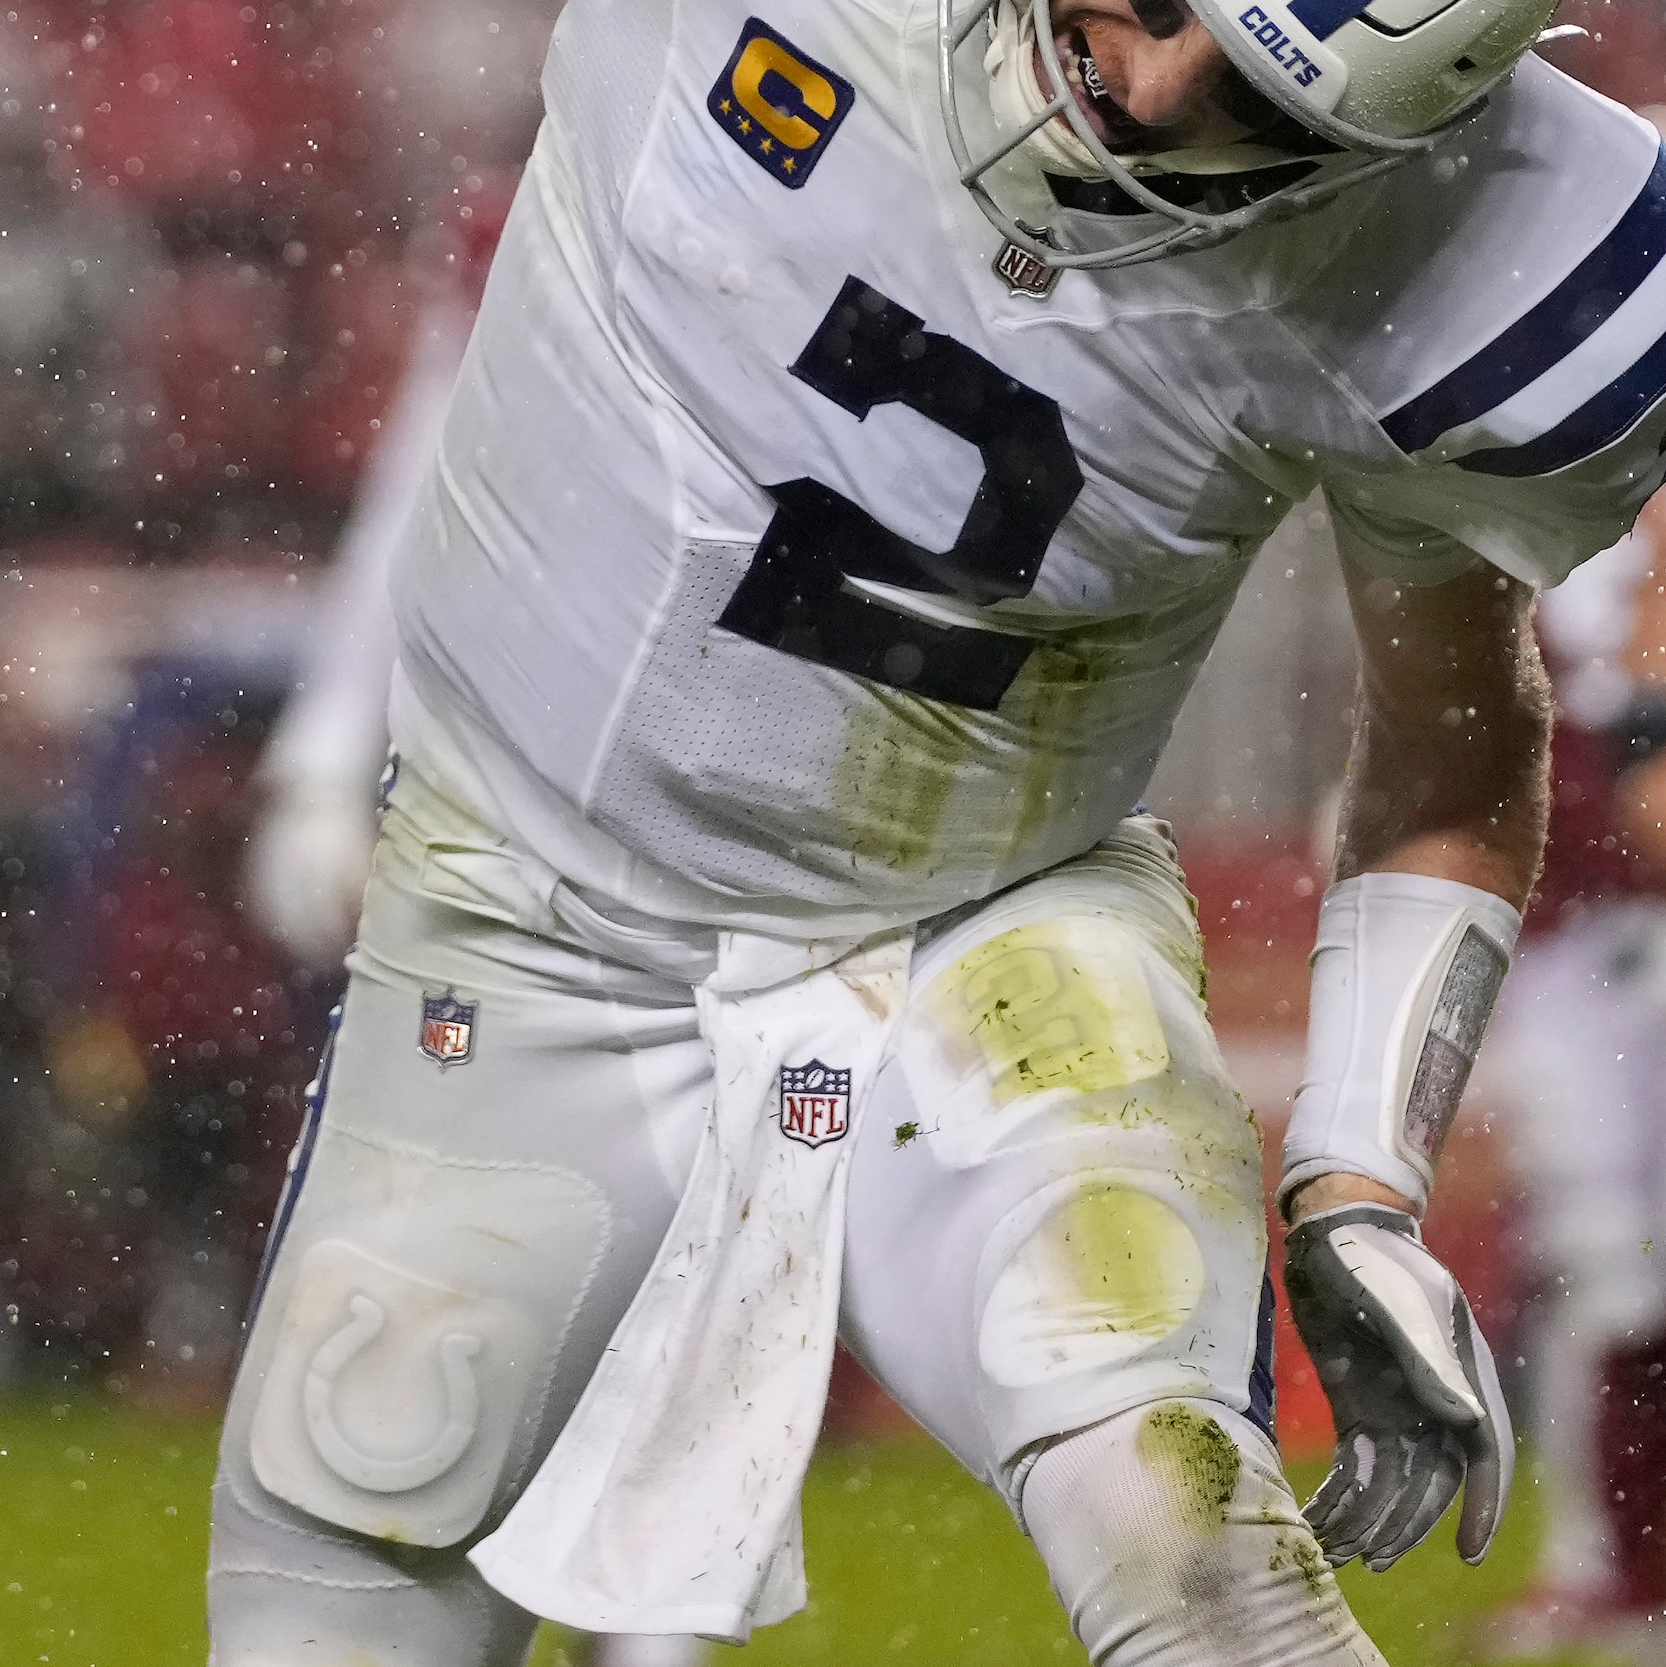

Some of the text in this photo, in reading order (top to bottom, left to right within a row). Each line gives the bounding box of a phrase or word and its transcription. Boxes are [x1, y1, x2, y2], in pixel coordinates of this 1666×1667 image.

[1238, 5, 1323, 88] COLTS
[732, 37, 837, 151] C
[1000, 246, 1048, 288] NFL
[714, 274, 1086, 712] 2
[424, 1020, 468, 1055] NFL
[785, 1096, 845, 1139] NFL
